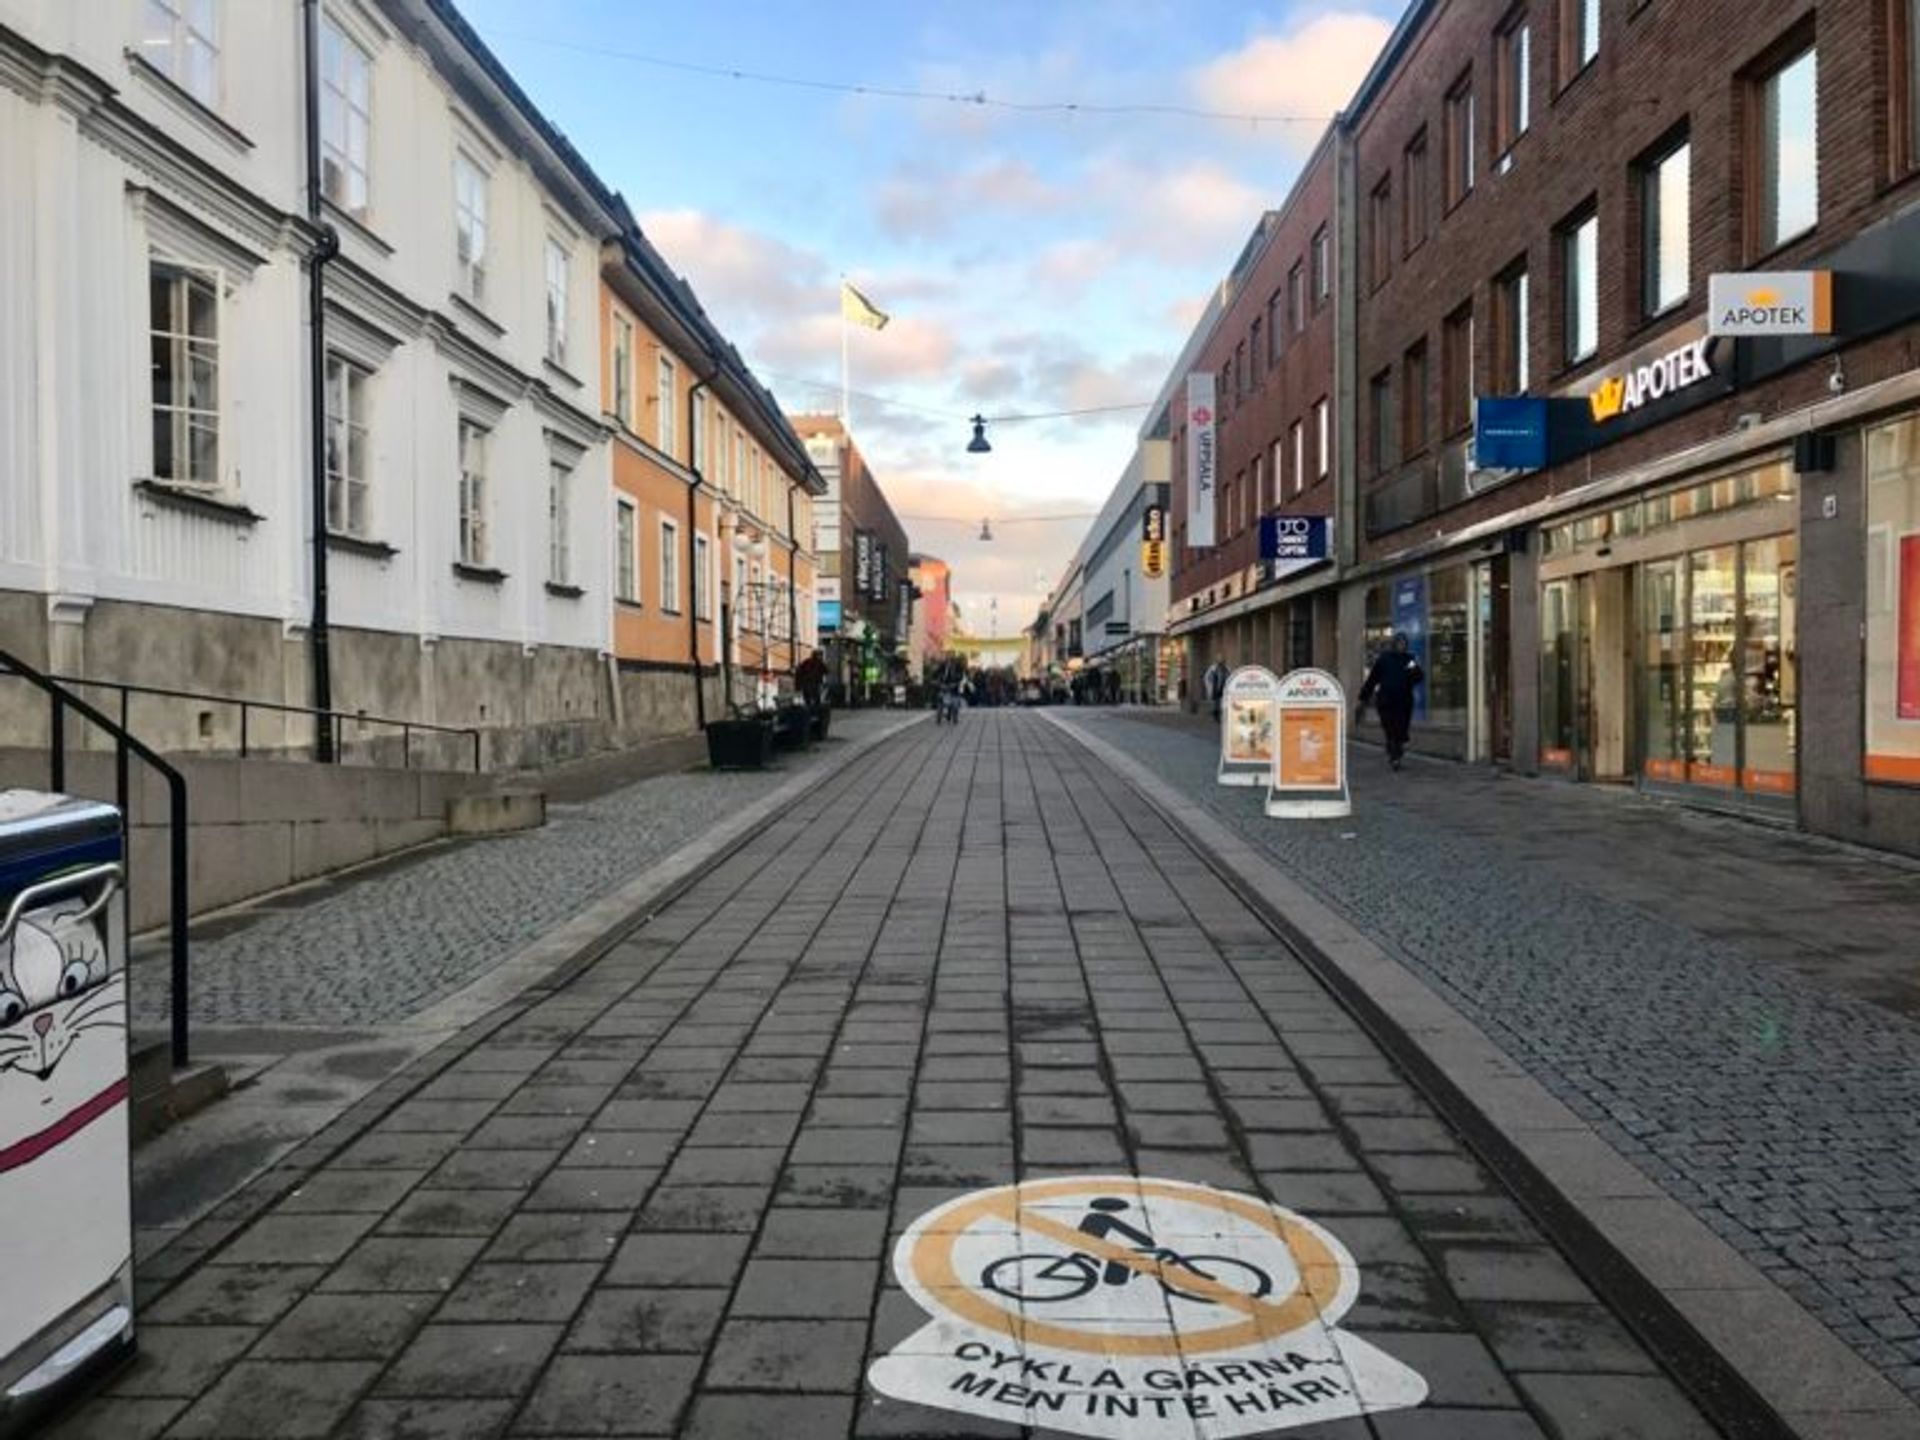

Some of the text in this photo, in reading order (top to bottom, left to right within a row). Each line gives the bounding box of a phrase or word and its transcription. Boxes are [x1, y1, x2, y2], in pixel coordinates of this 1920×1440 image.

[1722, 307, 1805, 326] APOTEK
[1622, 335, 1712, 412] APOTEK
[1199, 431, 1212, 492] UPPSALA
[955, 1342, 1125, 1389] CYKLA
[950, 1371, 1350, 1419] MEN INTE HÄR!
